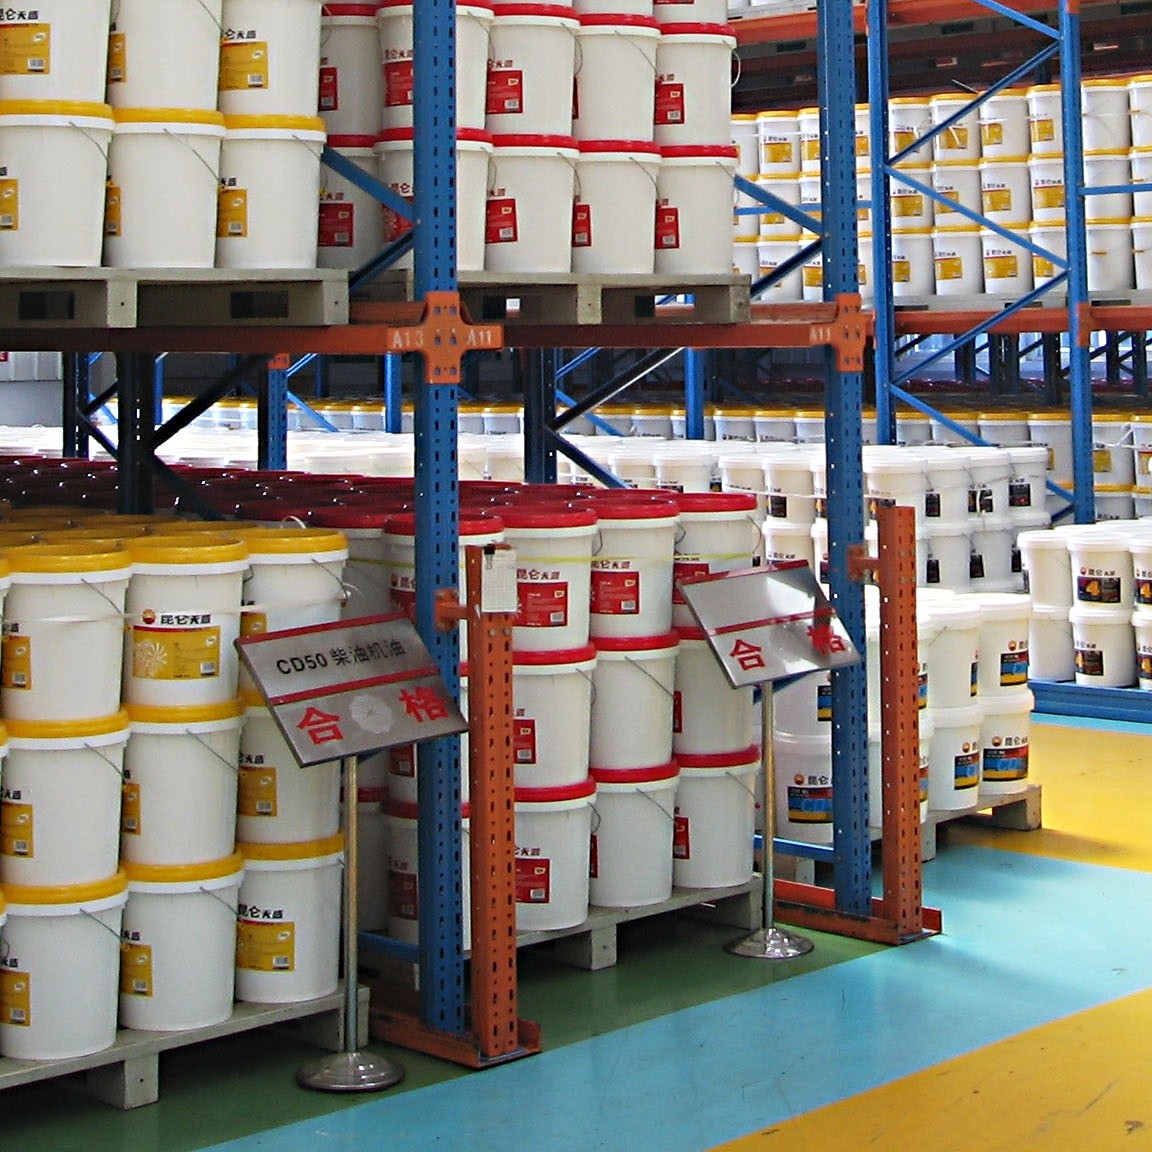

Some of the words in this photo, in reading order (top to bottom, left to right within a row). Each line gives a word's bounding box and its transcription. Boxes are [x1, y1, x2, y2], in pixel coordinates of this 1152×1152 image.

[392, 329, 425, 349] A13
[466, 329, 493, 347] A11
[277, 652, 328, 676] CD50
[330, 639, 407, 666] 柴油机油
[297, 686, 449, 746] 合格
